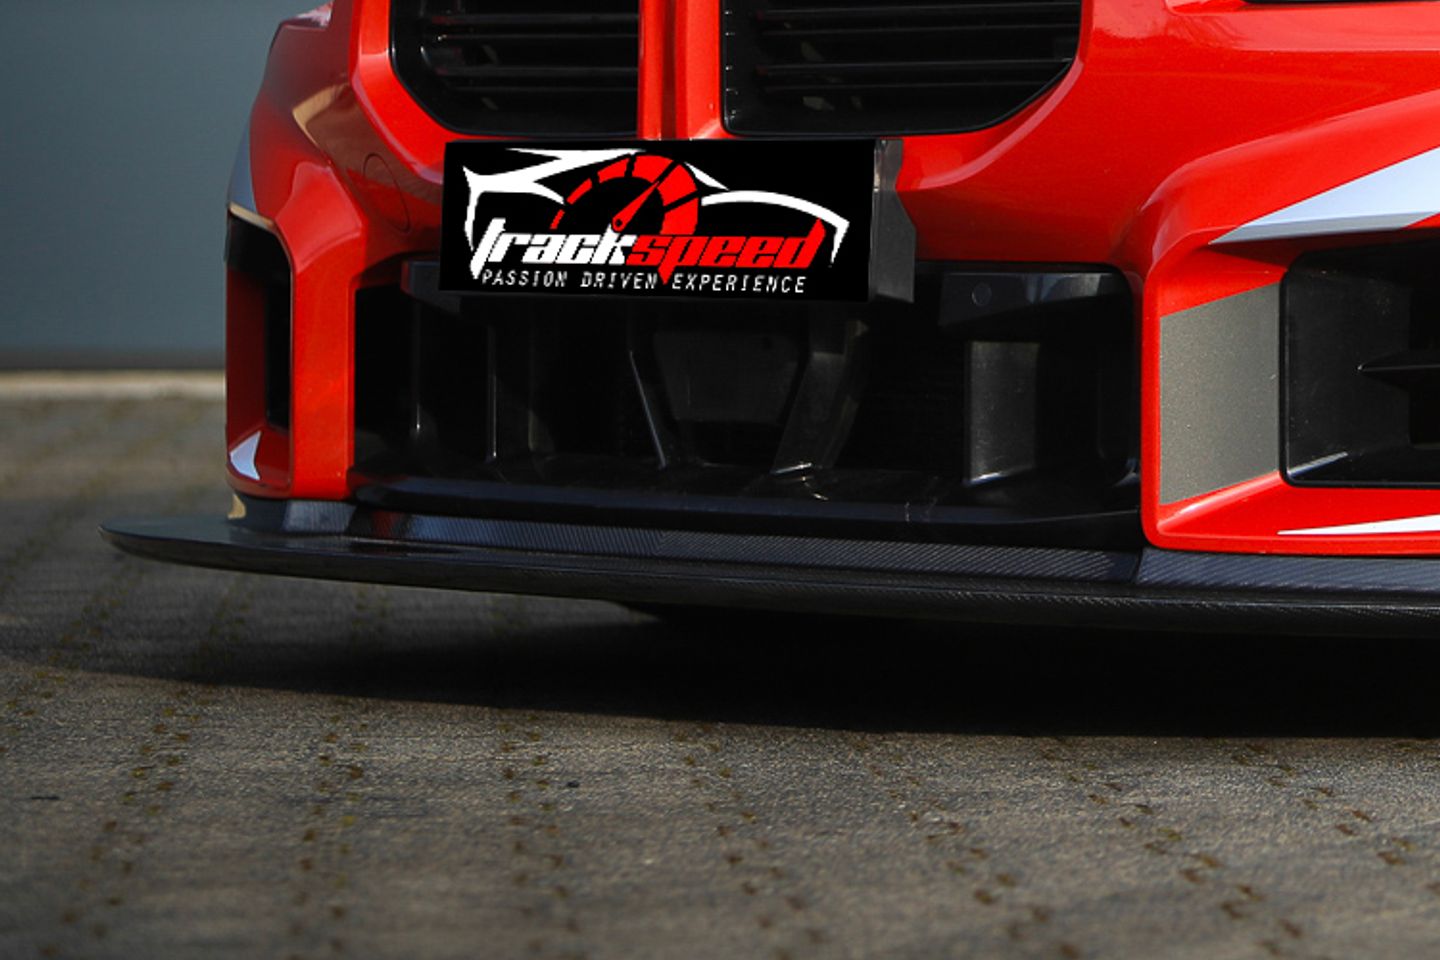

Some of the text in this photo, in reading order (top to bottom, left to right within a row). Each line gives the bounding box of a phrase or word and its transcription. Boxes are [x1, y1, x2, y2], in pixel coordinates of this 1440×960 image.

[482, 268, 807, 294] PASSION DRIVEN EXPERIENCE
